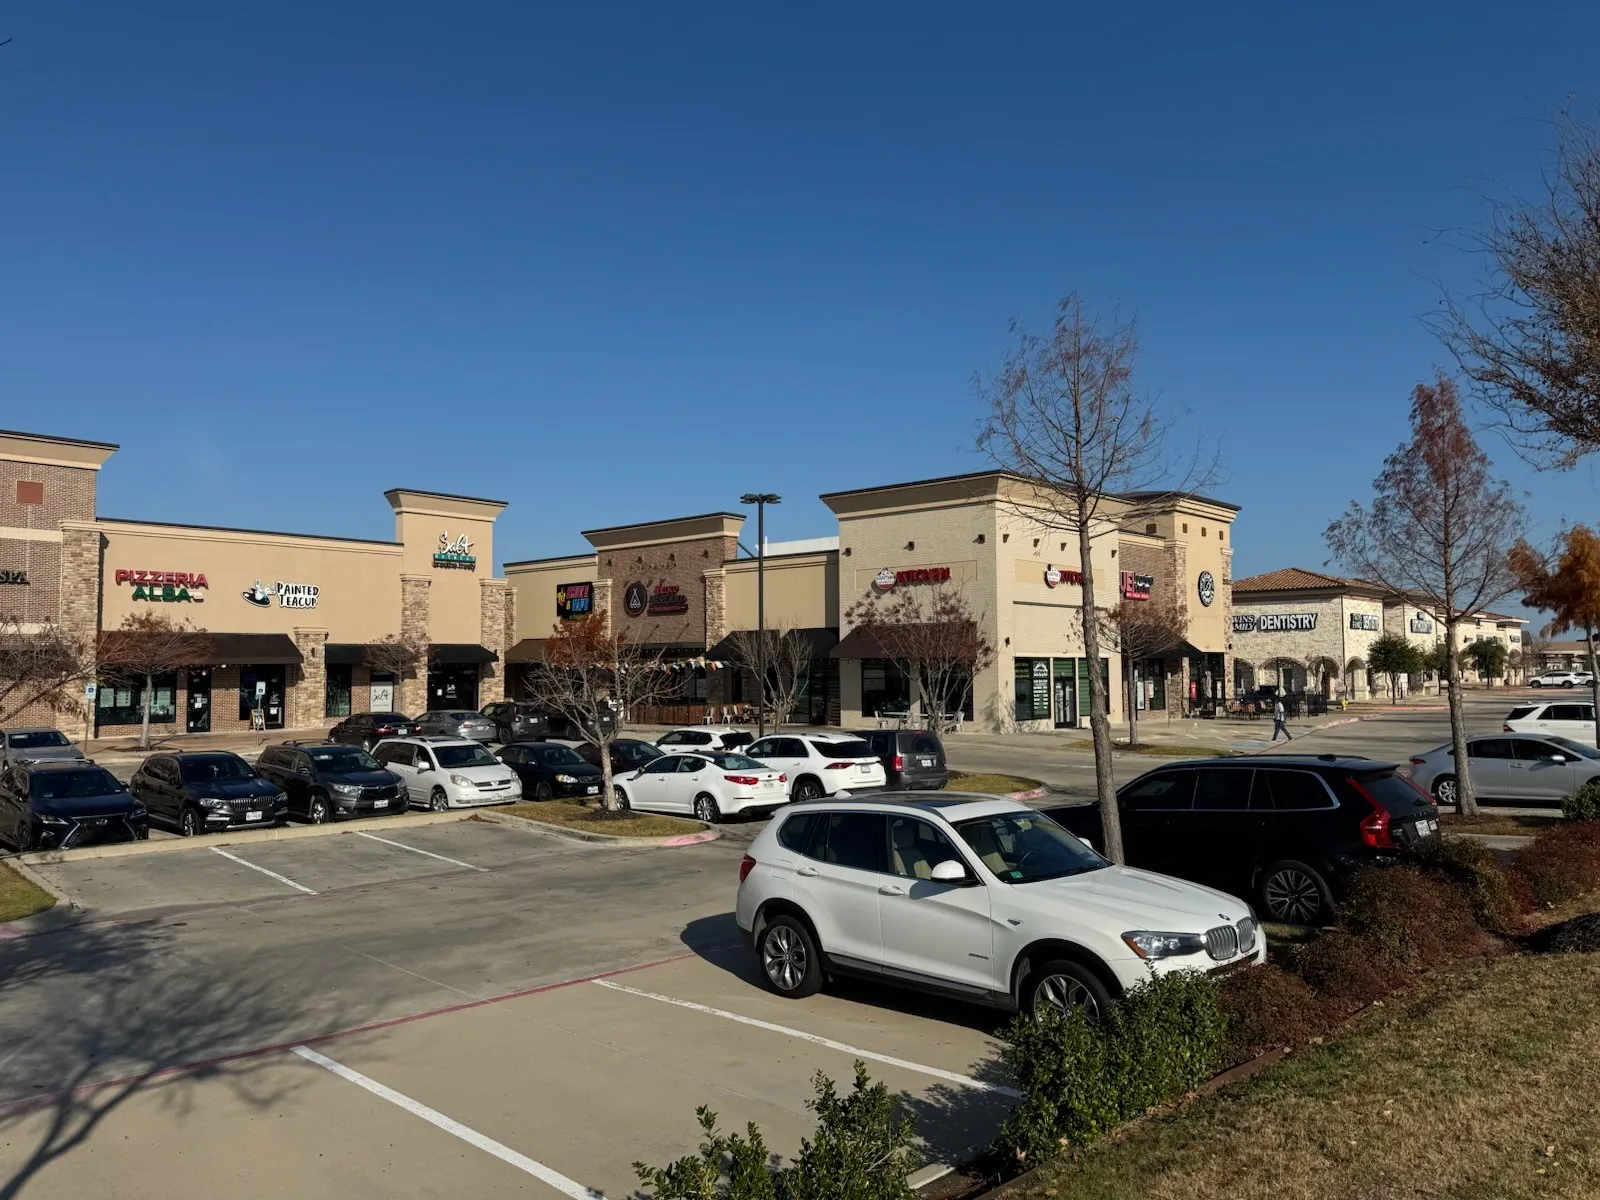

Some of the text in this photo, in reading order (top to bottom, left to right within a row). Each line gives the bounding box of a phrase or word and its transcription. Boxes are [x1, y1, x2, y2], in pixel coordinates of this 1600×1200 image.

[438, 530, 474, 555] Salt
[0, 570, 29, 583] SPA
[115, 569, 208, 588] PIZZERIA
[132, 585, 192, 602] ALBA
[277, 582, 319, 596] PAINTED
[279, 594, 317, 606] TEACUP
[1232, 622, 1257, 631] MILY
[1260, 613, 1318, 631] DENTISTRY
